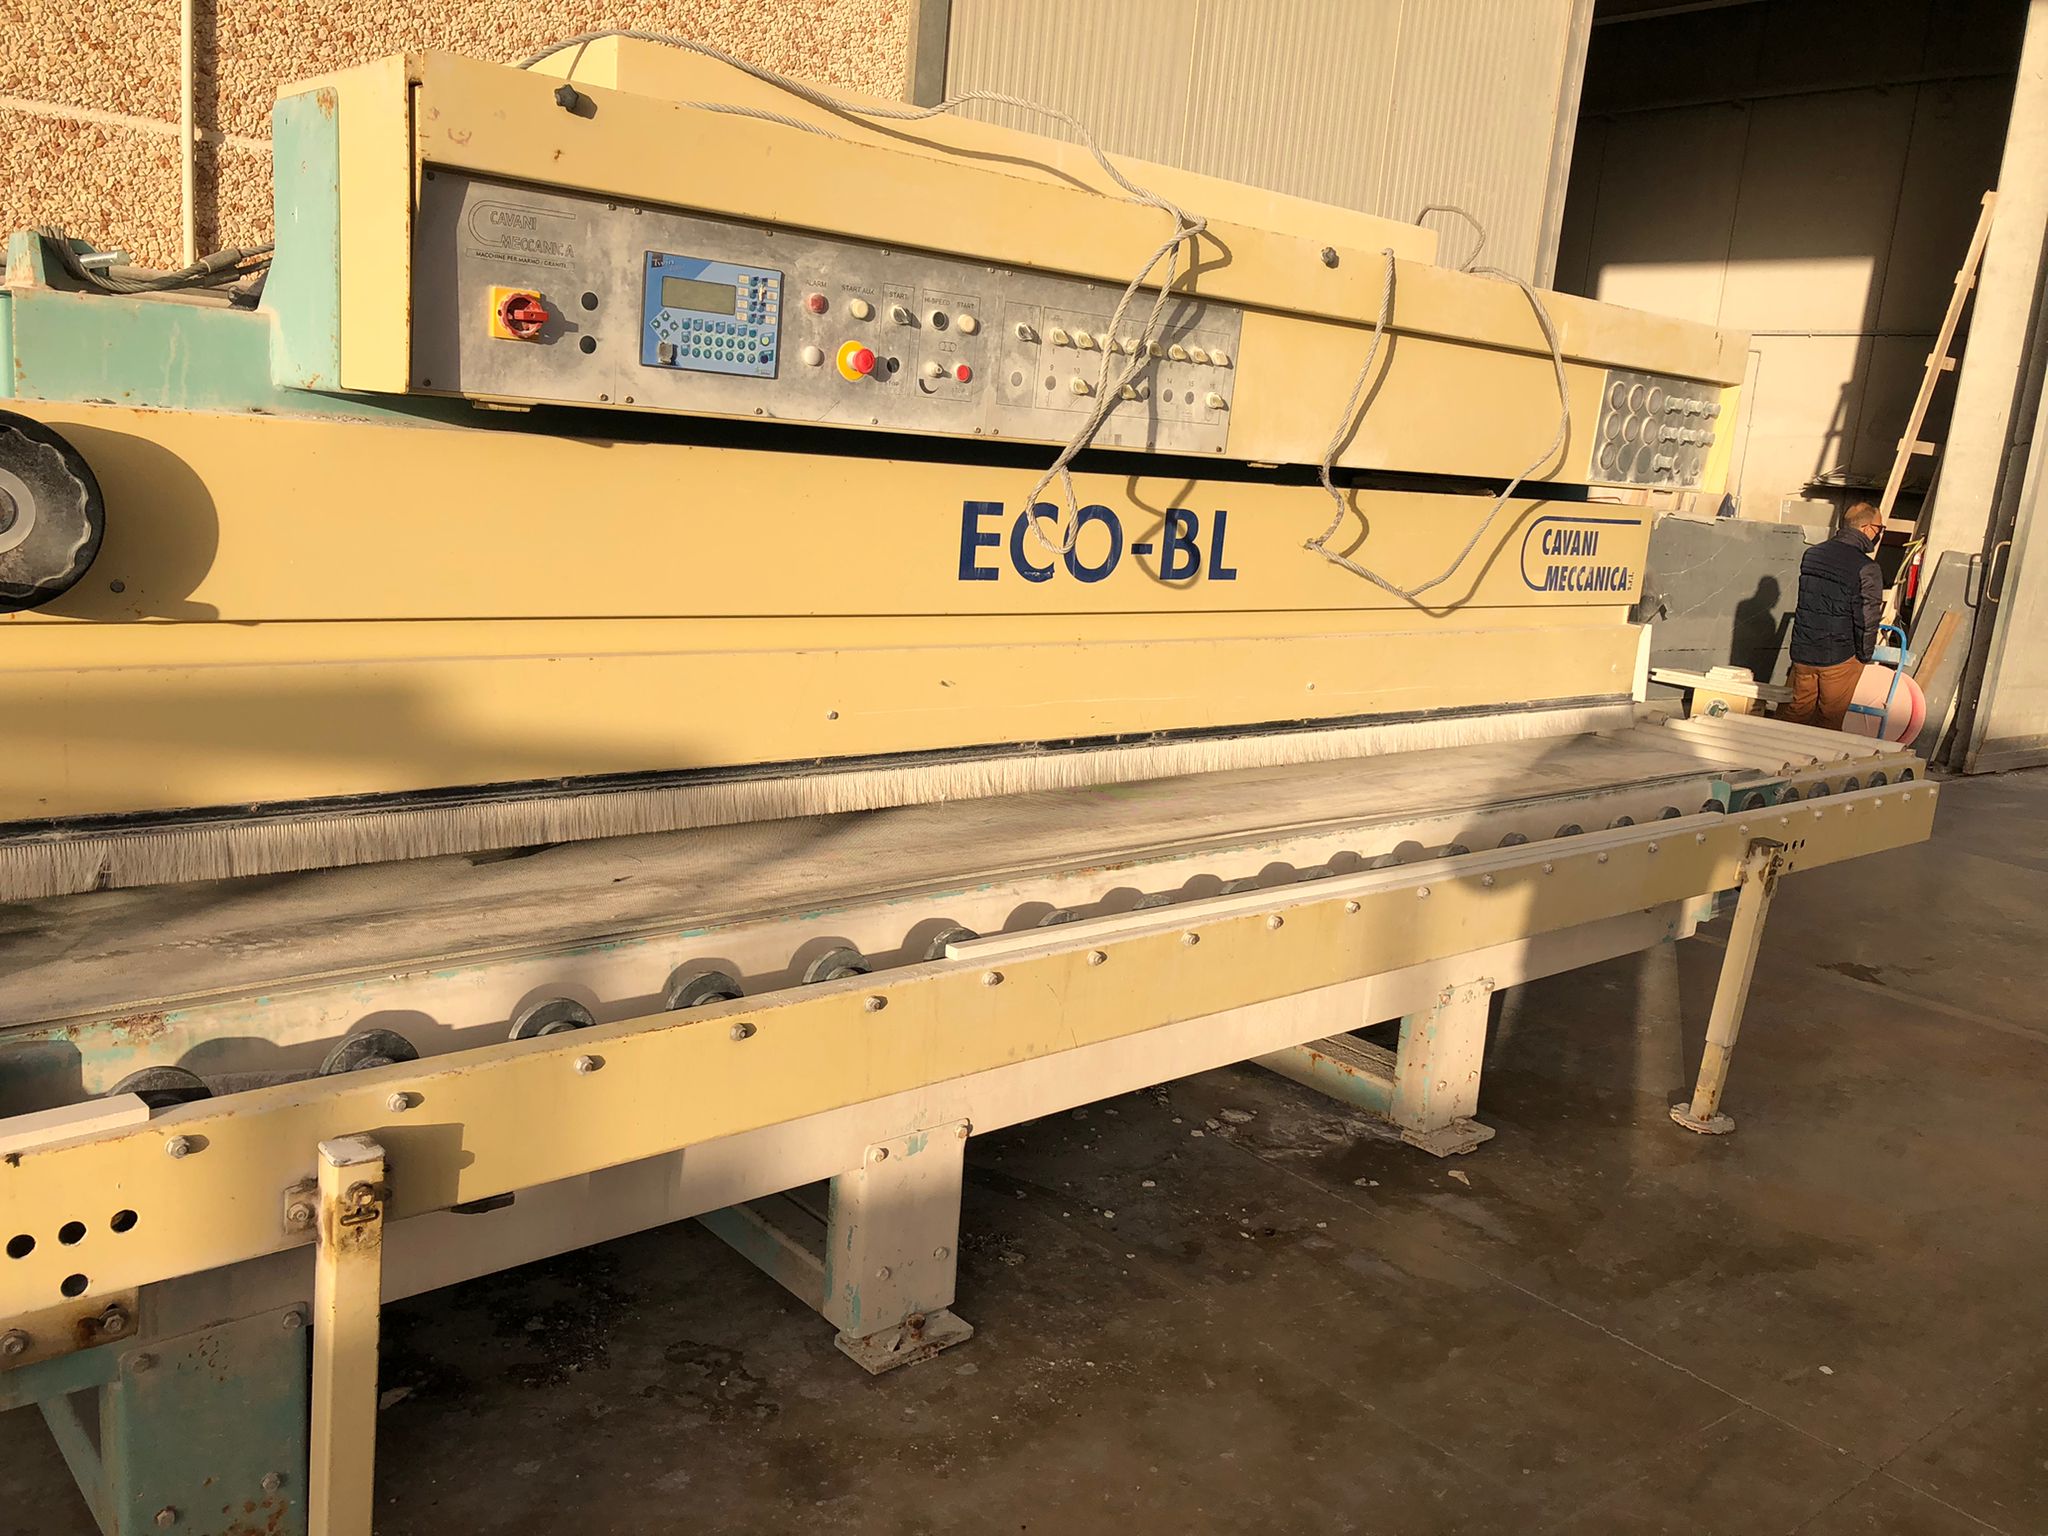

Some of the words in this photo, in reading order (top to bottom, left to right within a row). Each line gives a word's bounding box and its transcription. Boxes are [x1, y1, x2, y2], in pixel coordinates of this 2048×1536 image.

[489, 210, 537, 231] CAVANI
[500, 234, 574, 258] MECCANICA
[805, 279, 827, 288] ALARM
[841, 284, 862, 294] START
[889, 291, 908, 299] START
[957, 301, 975, 309] START
[958, 500, 1238, 583] ECO-BL
[1542, 528, 1599, 556] CAVANI
[1545, 565, 1628, 592] MECCANICA
